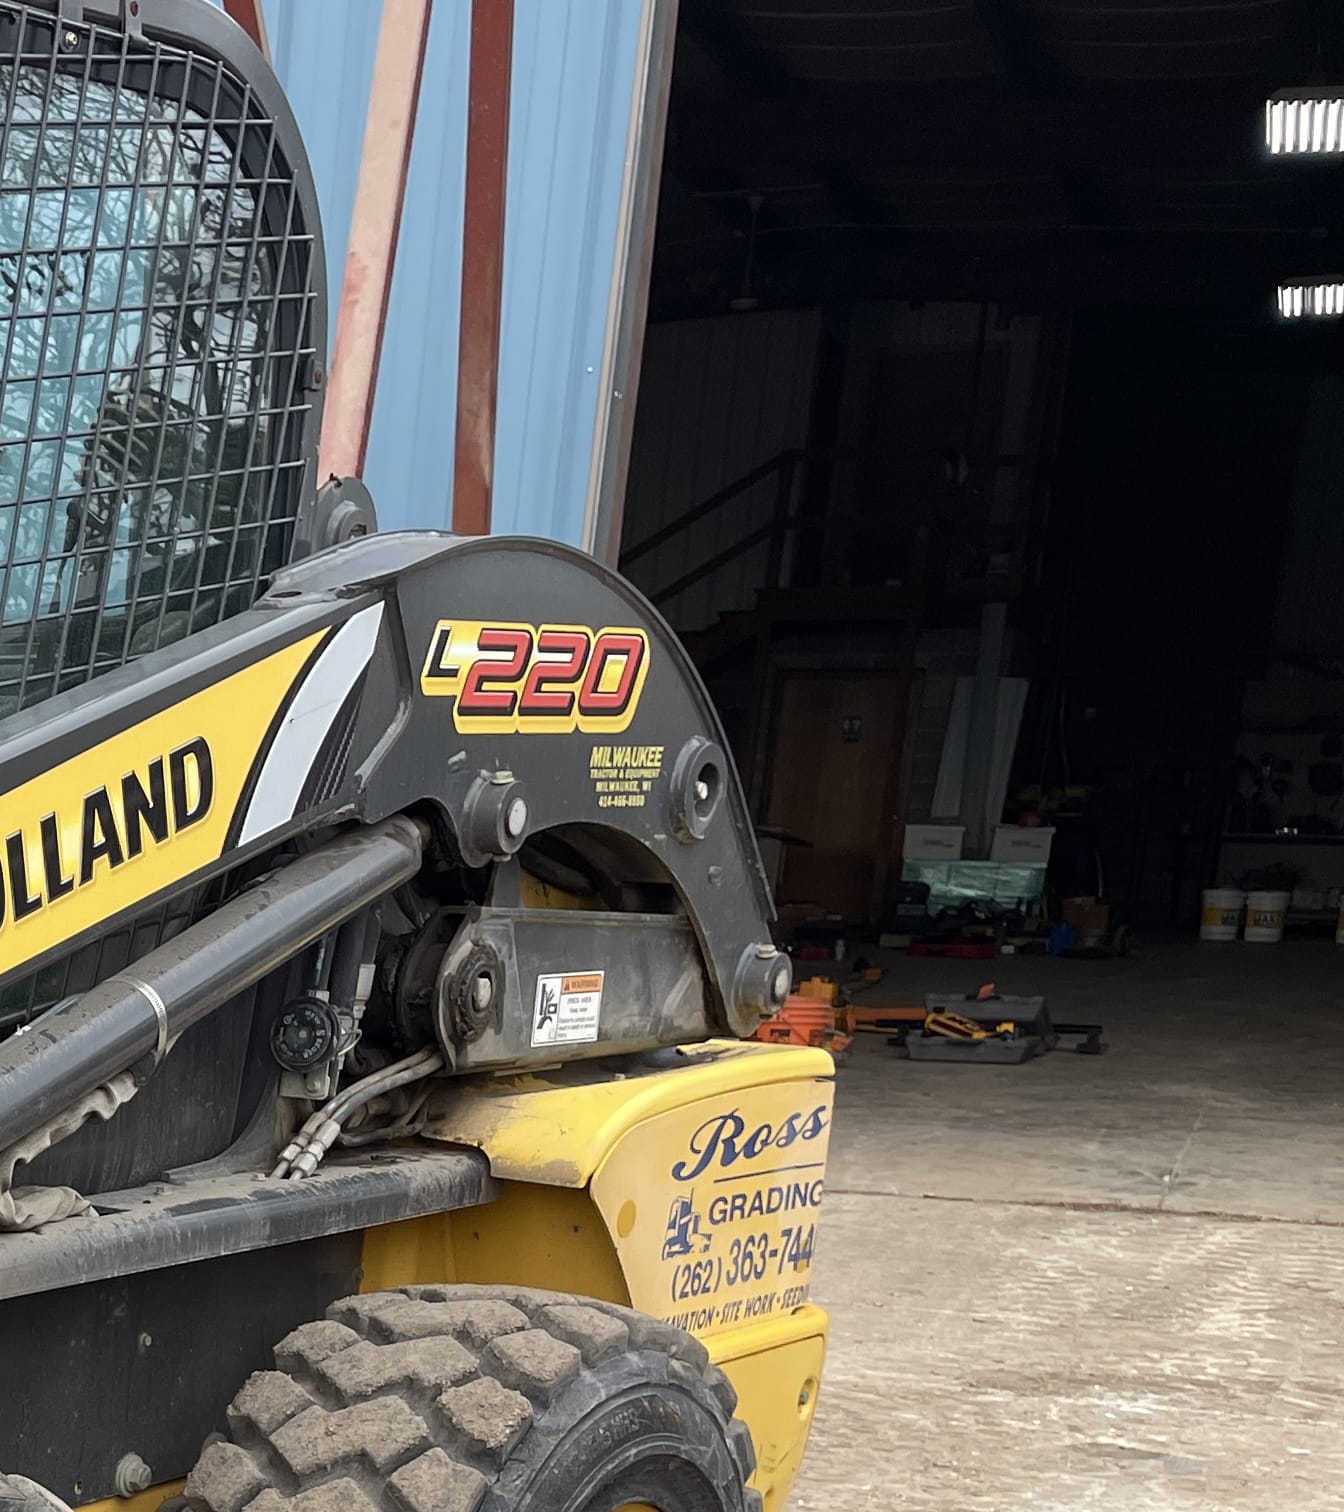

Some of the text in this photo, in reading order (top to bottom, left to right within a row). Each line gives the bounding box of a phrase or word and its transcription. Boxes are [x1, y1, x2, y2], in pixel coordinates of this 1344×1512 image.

[422, 621, 648, 722] L220
[589, 746, 664, 768] MILWAUKEE
[671, 1104, 830, 1182] Ross
[671, 1256, 722, 1302] (262)
[719, 1299, 743, 1324] SITE
[743, 1291, 777, 1319] WORK
